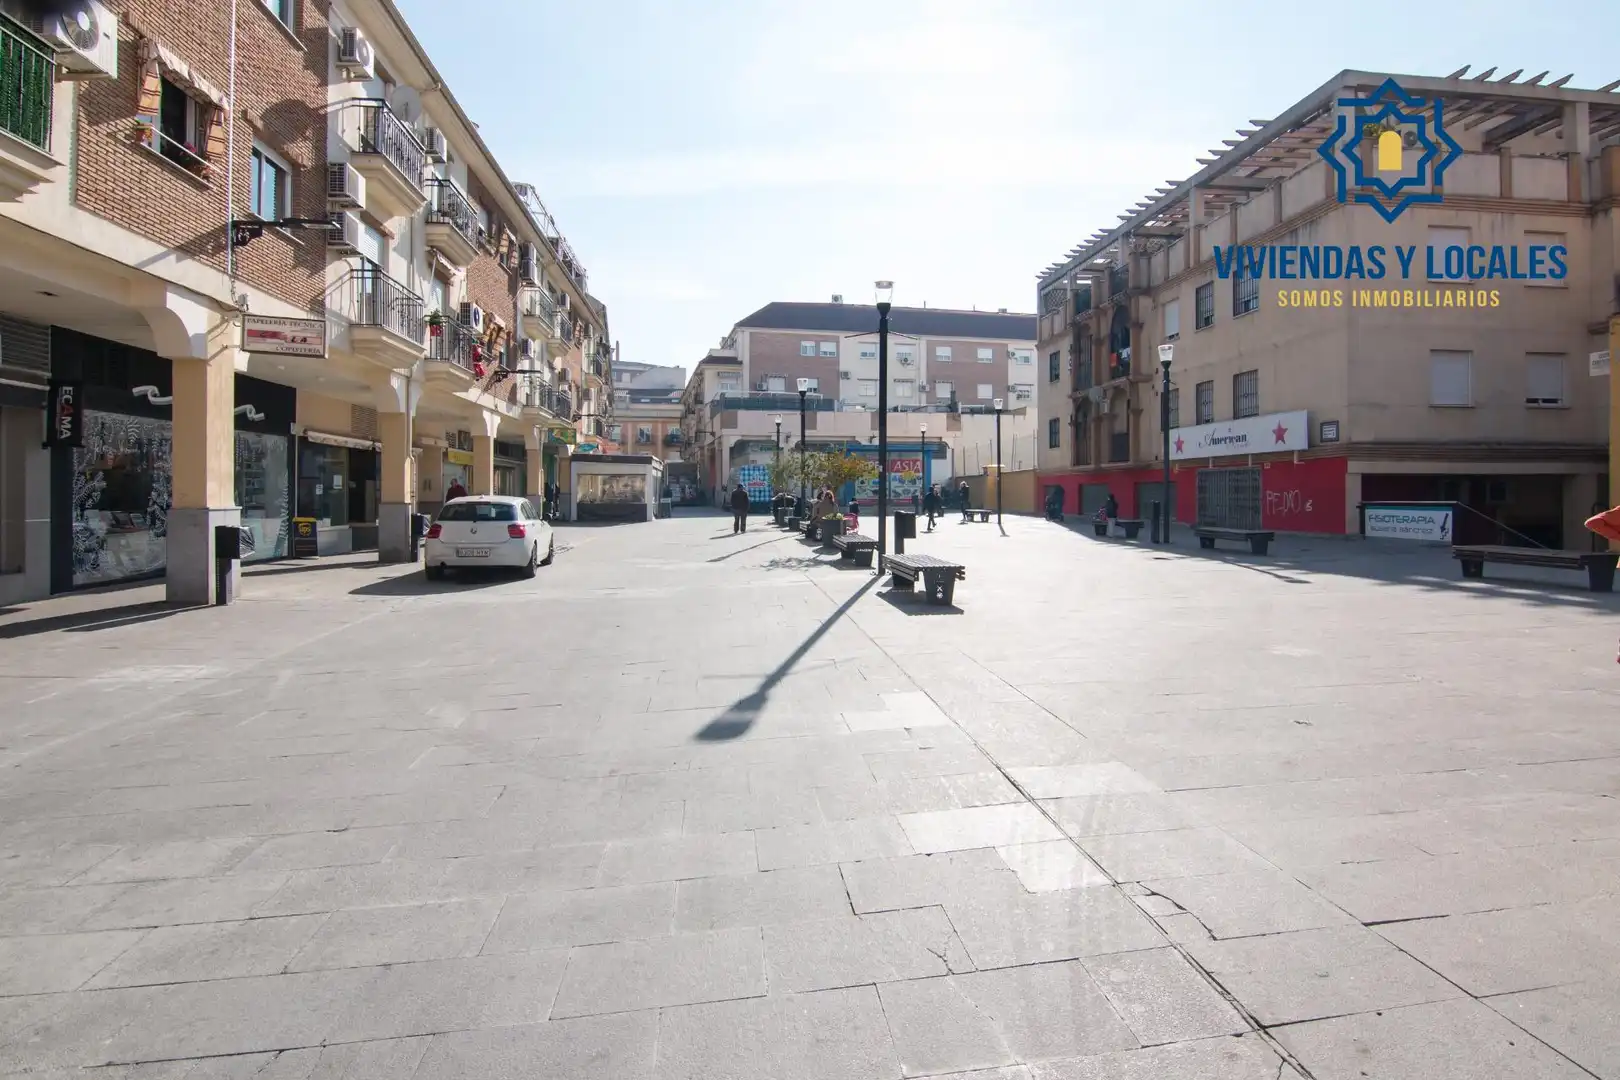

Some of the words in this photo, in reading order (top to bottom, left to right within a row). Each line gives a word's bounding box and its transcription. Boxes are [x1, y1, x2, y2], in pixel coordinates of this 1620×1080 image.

[59, 386, 74, 439] ECAMA
[893, 460, 921, 472] ASIA
[1368, 514, 1435, 524] FISIOTERAPIA
